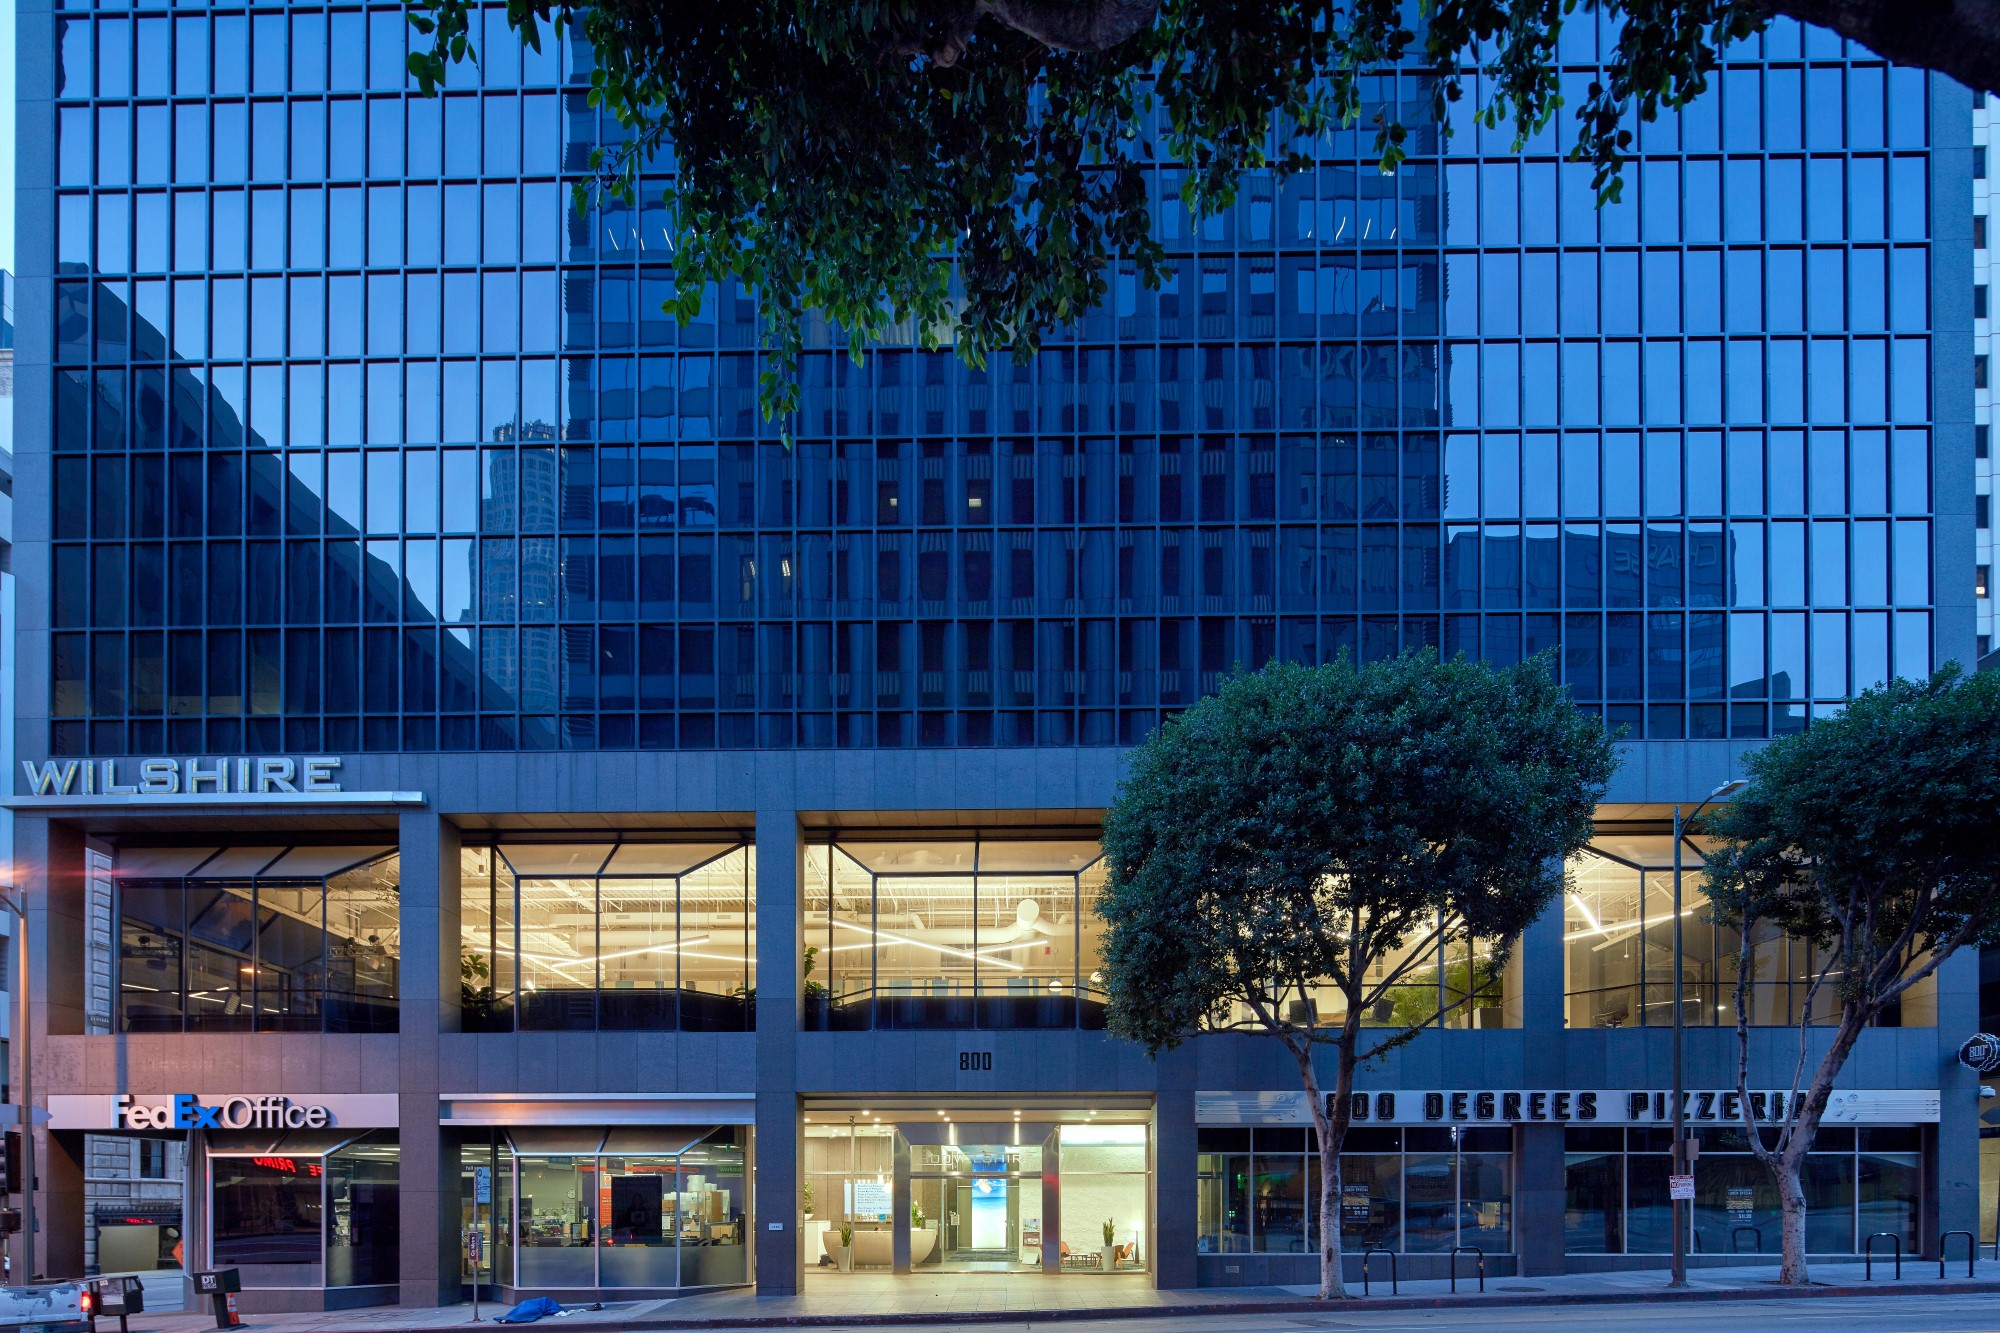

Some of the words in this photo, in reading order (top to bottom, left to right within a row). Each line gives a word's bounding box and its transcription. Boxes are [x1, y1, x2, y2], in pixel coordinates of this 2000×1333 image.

[22, 757, 341, 796] WILSHIRE
[959, 1051, 992, 1071] 800
[1424, 1092, 1597, 1121] DEGREES
